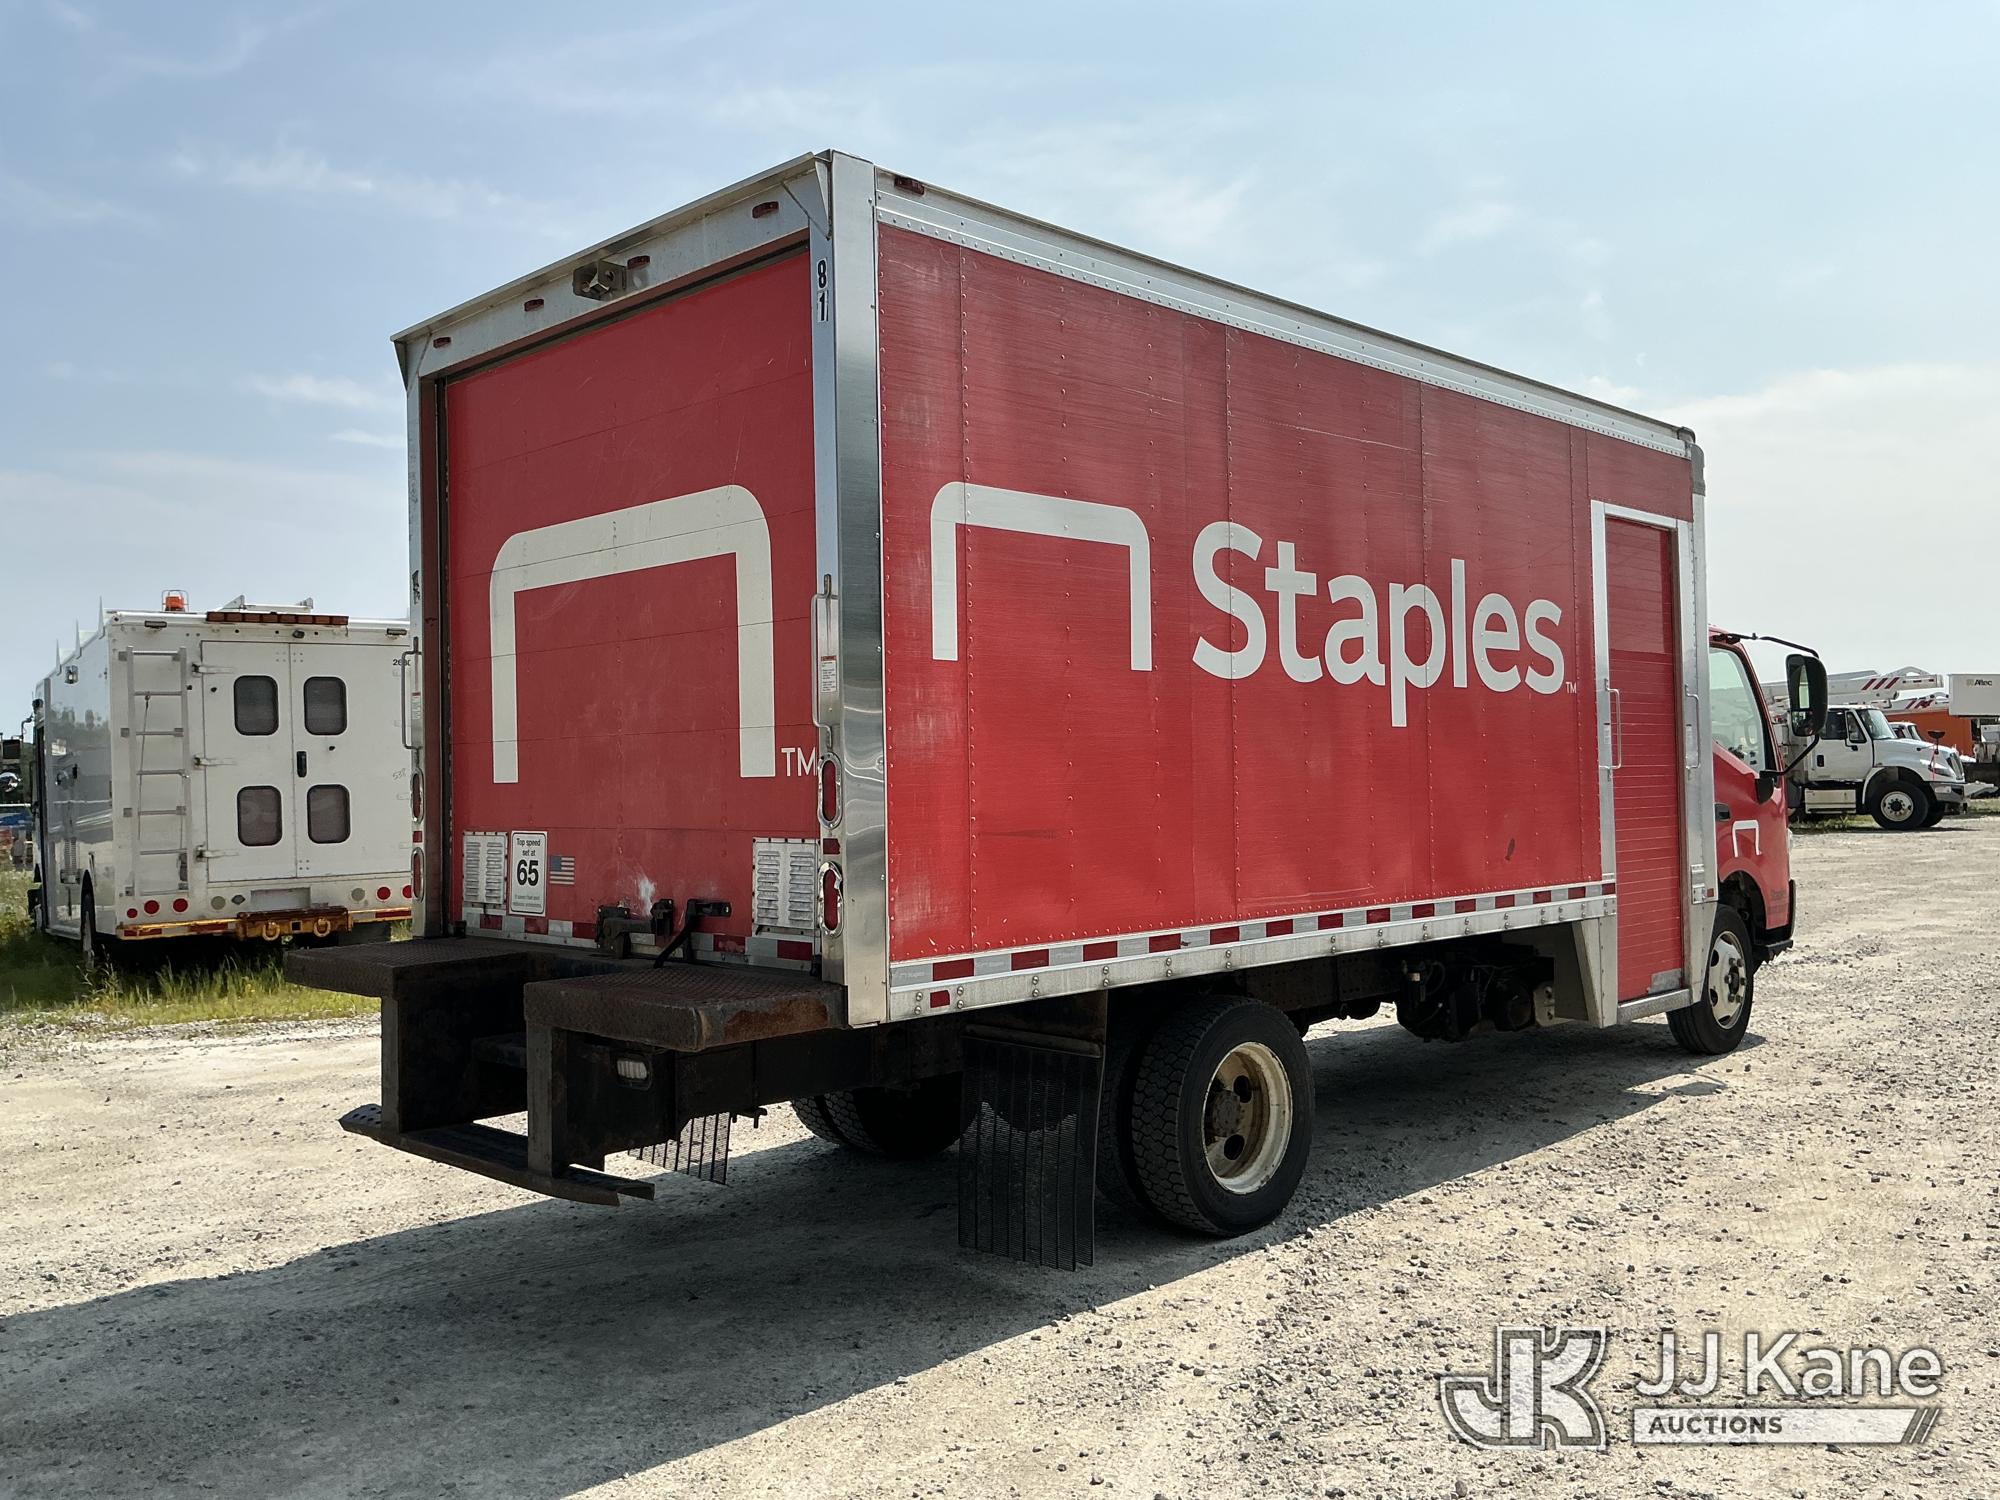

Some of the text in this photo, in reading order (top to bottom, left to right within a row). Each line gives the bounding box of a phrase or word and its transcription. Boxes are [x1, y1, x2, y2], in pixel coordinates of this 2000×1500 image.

[1192, 520, 1565, 728] Staples
[1565, 681, 1577, 694] TM
[781, 747, 817, 777] TM
[516, 838, 541, 847] Top speed
[522, 849, 536, 857] set at
[516, 859, 539, 887] 65
